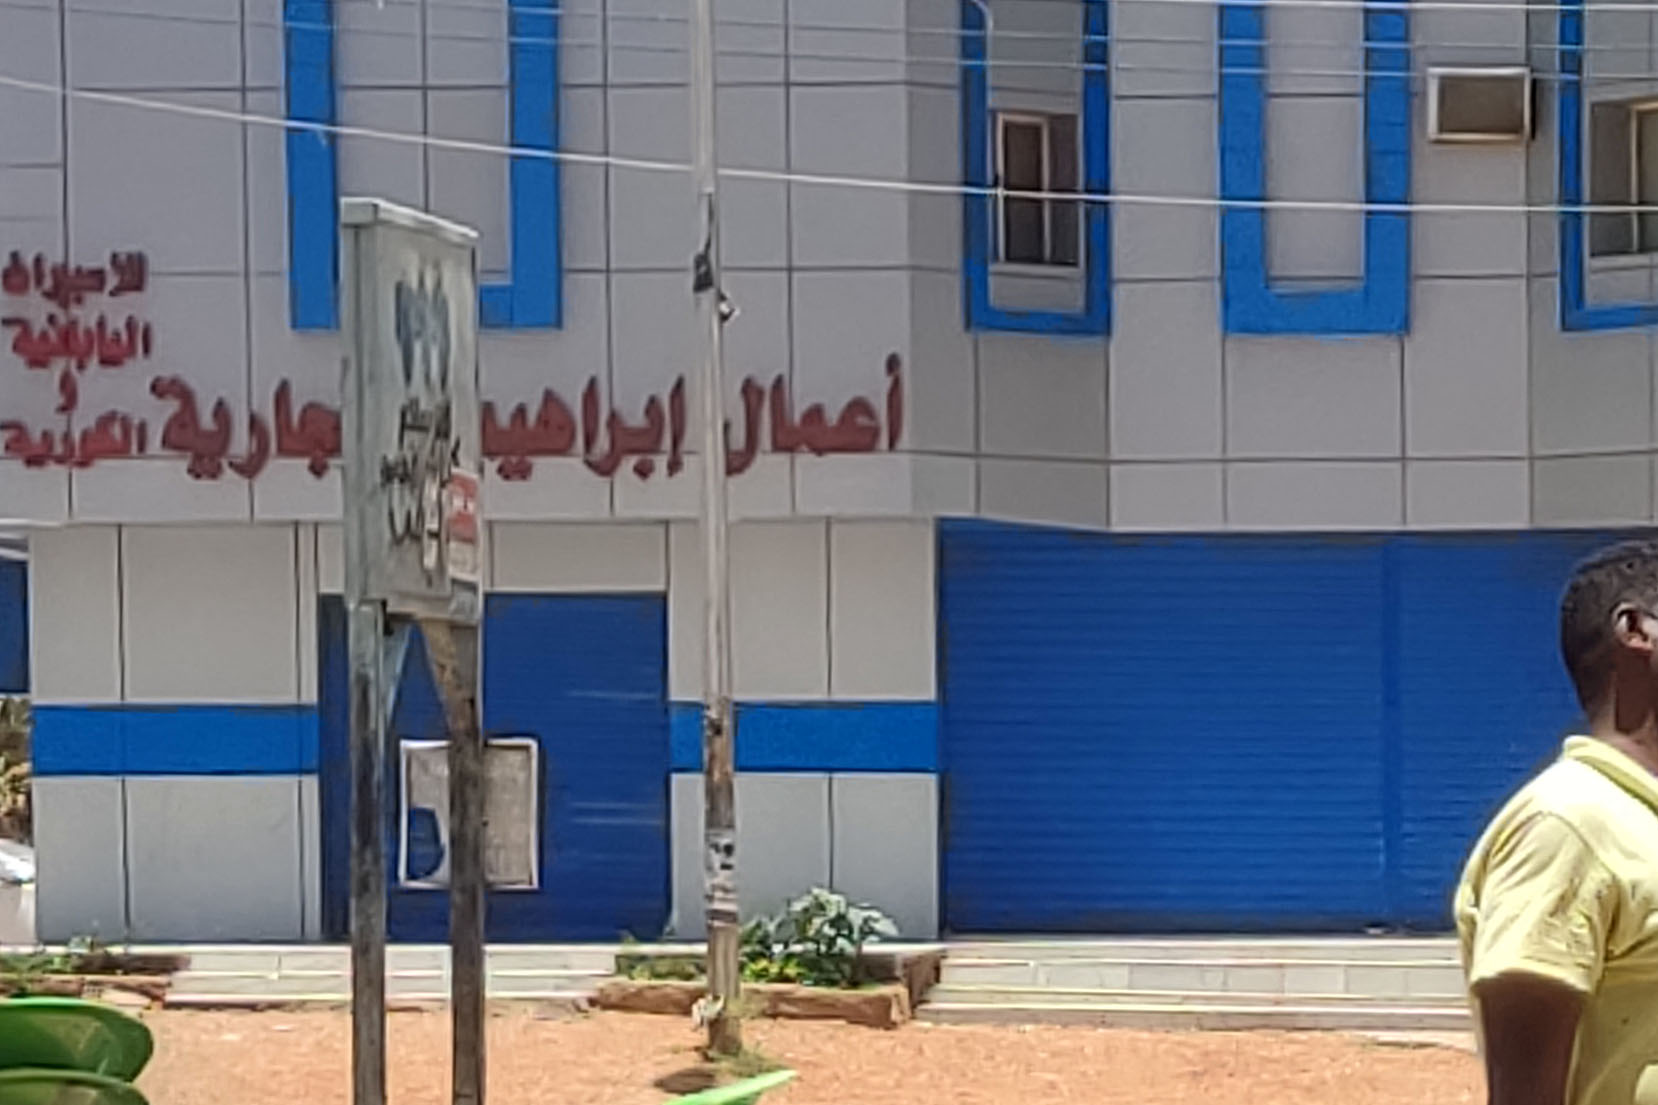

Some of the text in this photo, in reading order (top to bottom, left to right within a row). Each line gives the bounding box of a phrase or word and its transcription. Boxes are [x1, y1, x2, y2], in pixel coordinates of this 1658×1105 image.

[56, 370, 78, 414] و
[480, 373, 687, 479] إبراهي
[726, 352, 904, 477] أعمال
